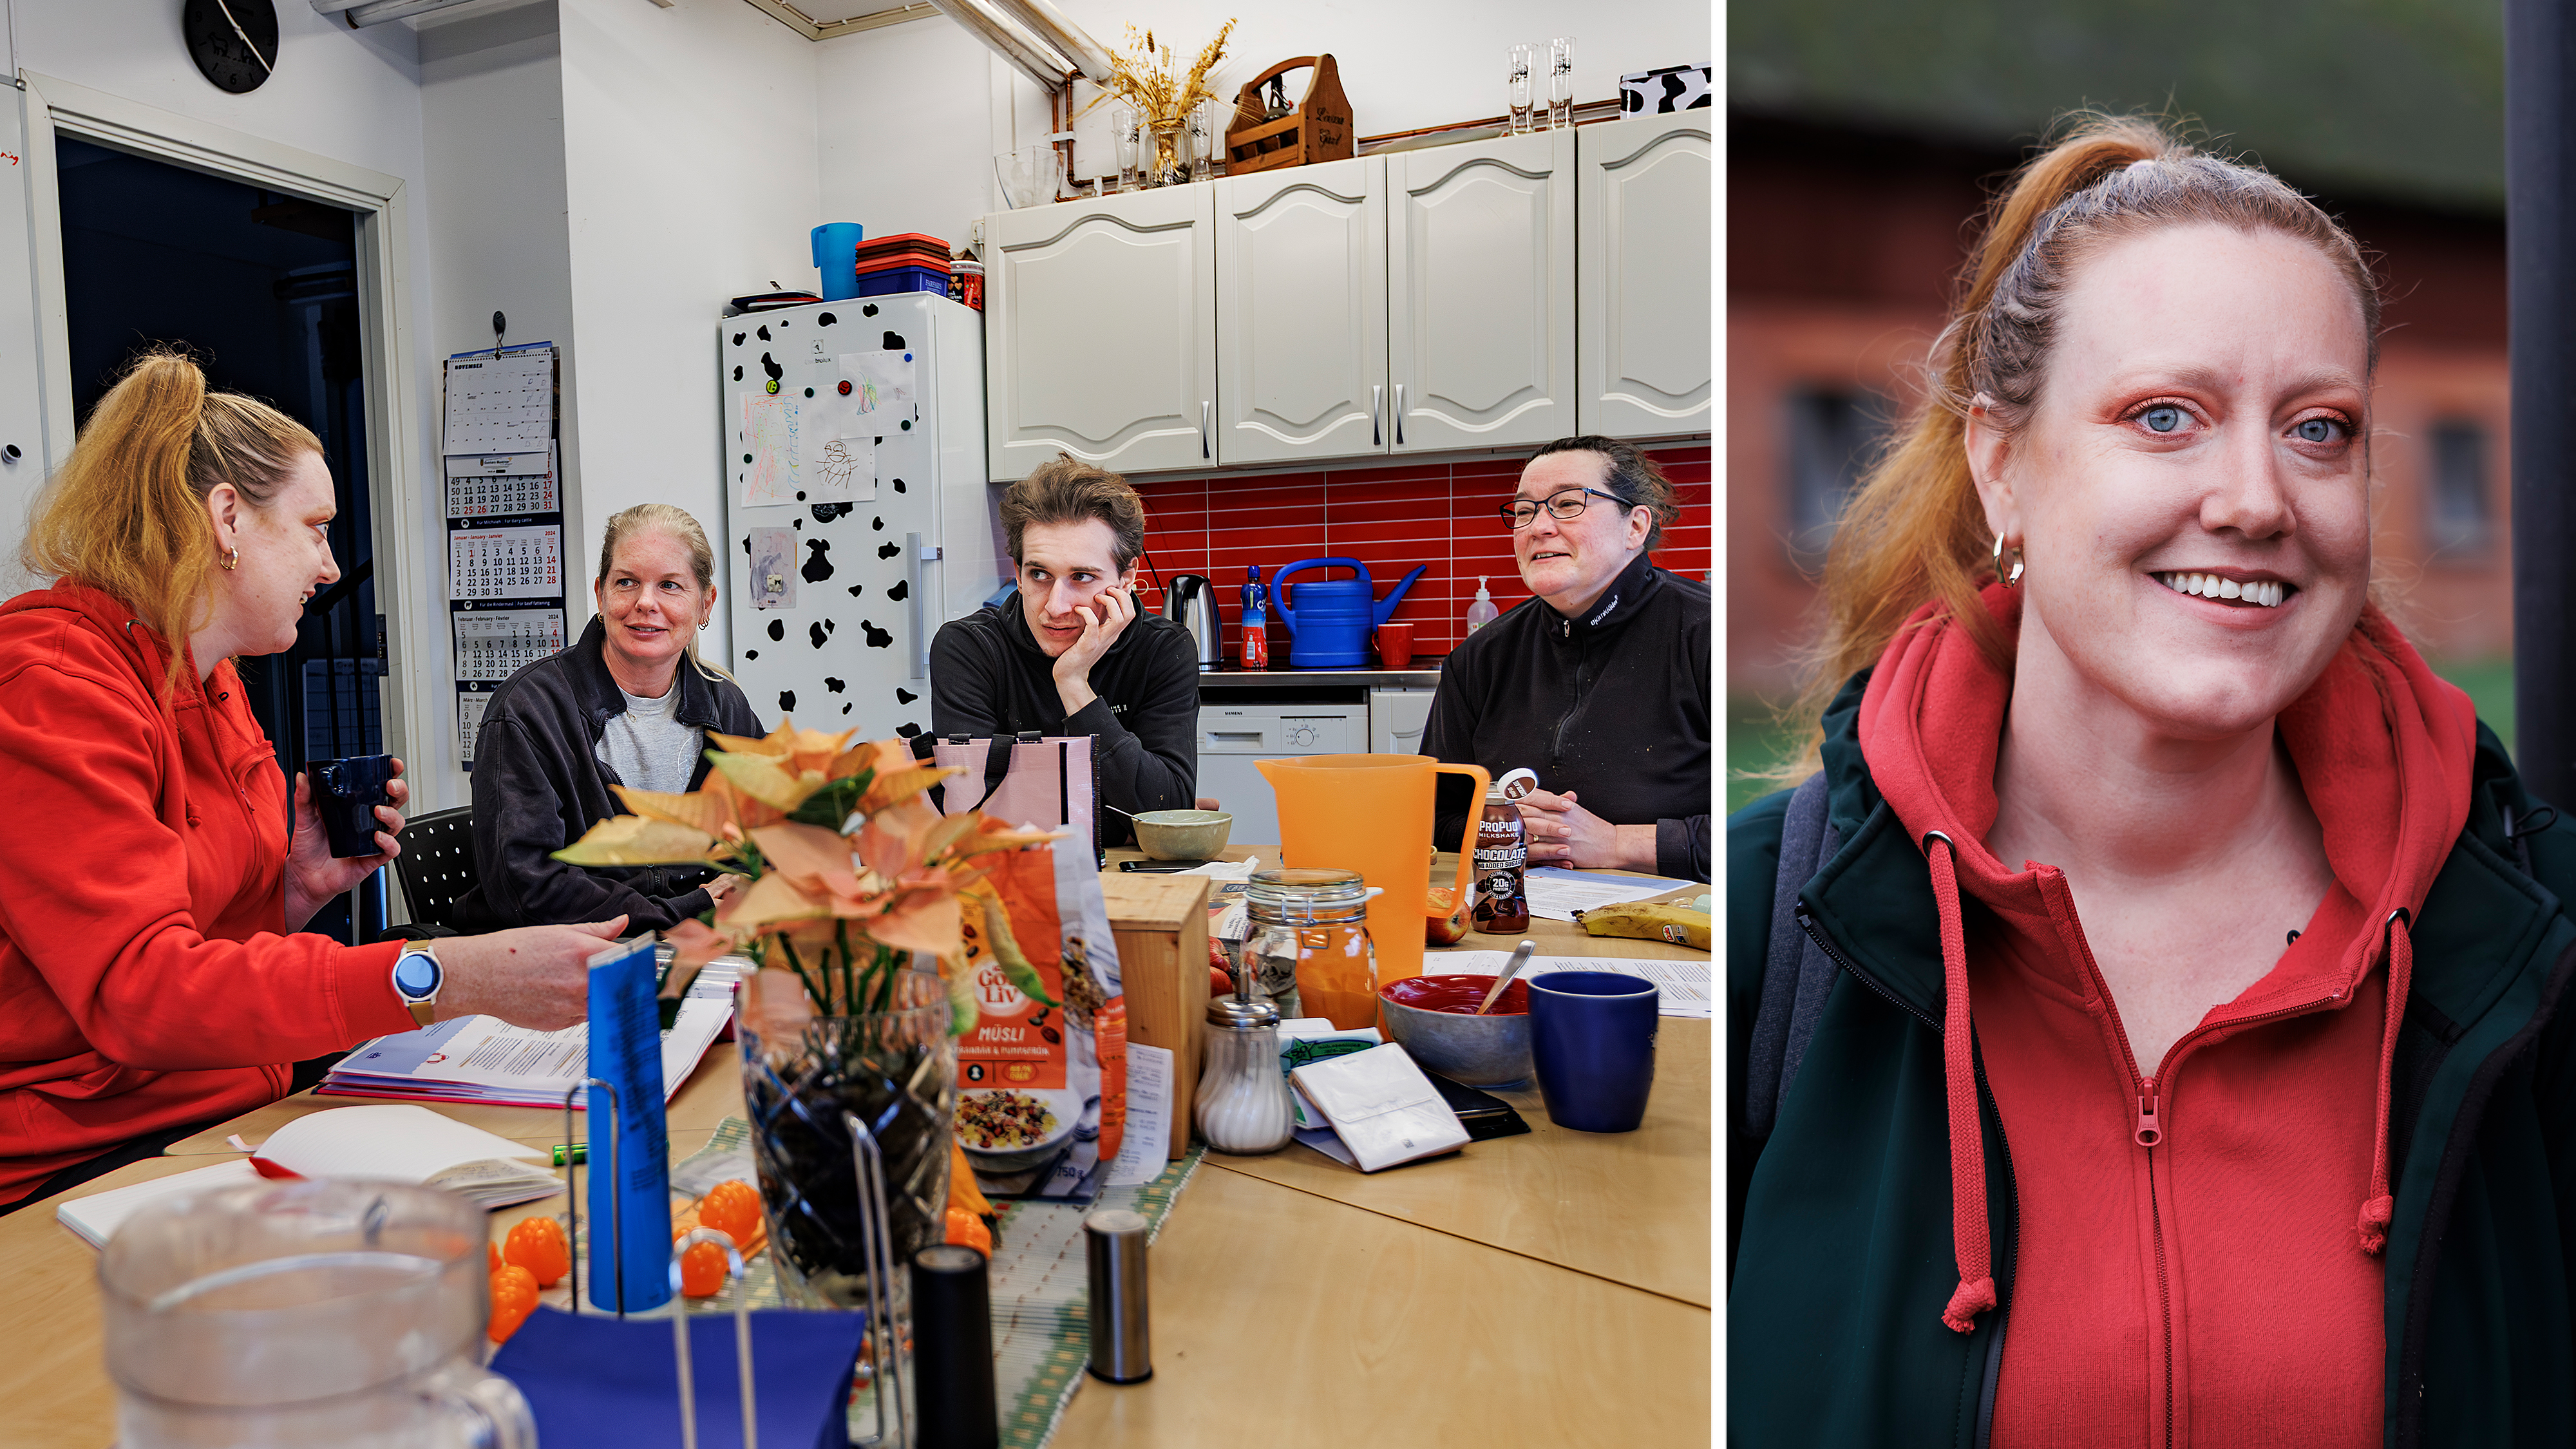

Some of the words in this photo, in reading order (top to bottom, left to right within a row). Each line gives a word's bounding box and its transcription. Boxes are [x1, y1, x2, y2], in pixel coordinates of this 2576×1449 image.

[195, 10, 203, 23] 9
[229, 73, 237, 85] 6
[504, 484, 512, 492] 14
[516, 482, 525, 491] 15
[530, 482, 539, 490] 16
[544, 480, 552, 489] 17
[477, 495, 486, 504] 19
[516, 493, 526, 501] 22
[544, 491, 552, 499] 24
[464, 506, 473, 515] 25
[477, 505, 486, 514] 26
[531, 502, 539, 510] 30
[544, 501, 552, 509] 31
[1473, 848, 1526, 861] CHOCOLATE
[978, 1024, 1026, 1042] MÜSLI
